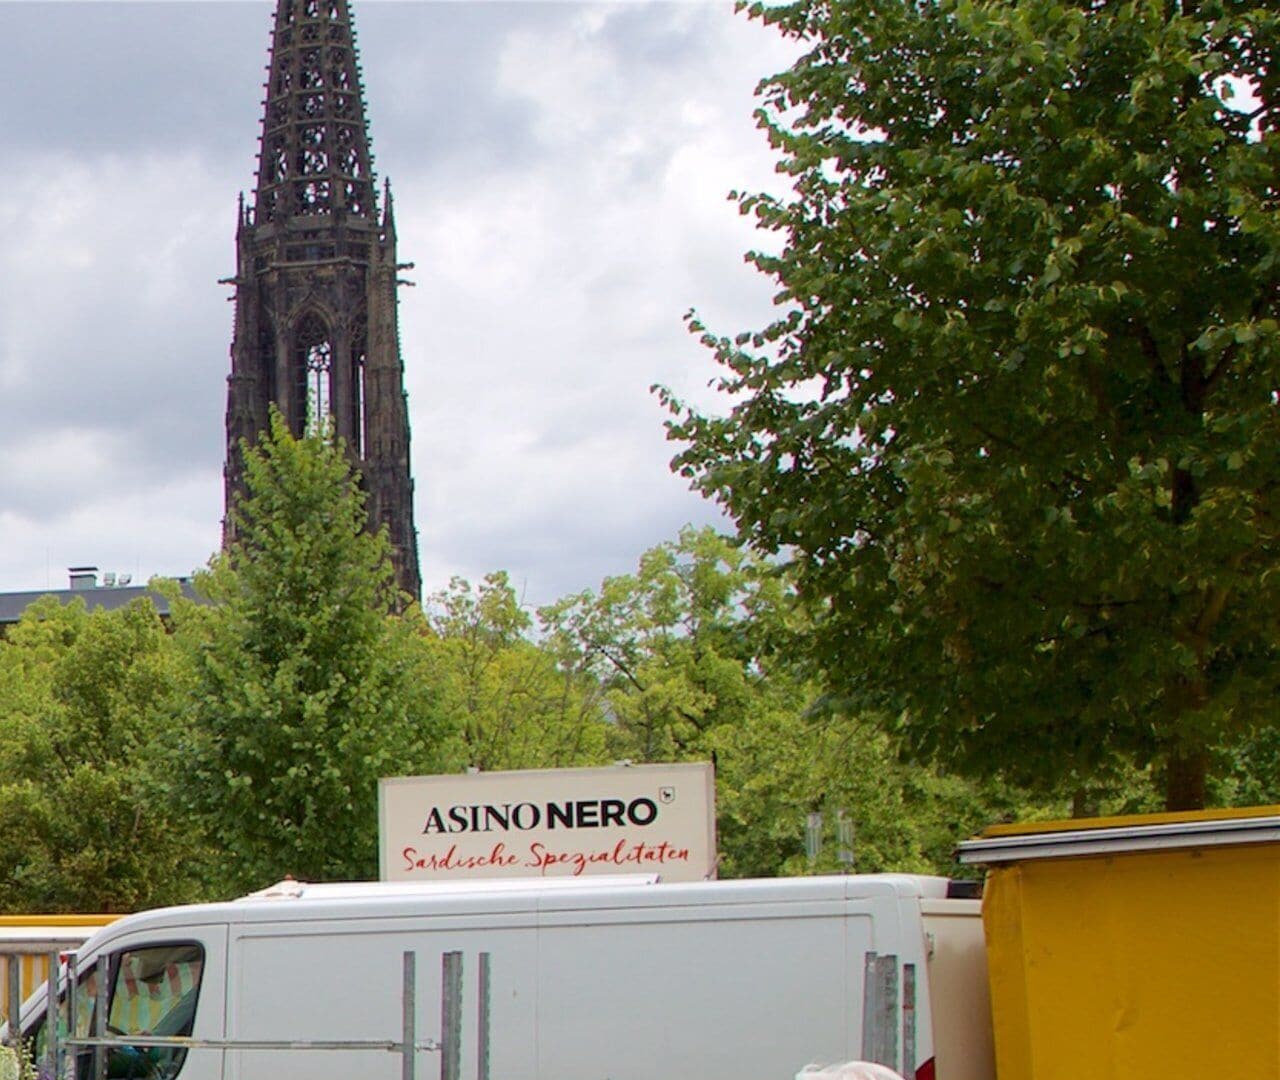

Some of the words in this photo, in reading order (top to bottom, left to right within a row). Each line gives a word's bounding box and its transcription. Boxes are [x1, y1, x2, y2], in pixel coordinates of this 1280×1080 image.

[422, 802, 541, 834] ASINO
[546, 798, 658, 829] NERO
[402, 842, 518, 872] Sardische
[525, 838, 689, 877] Spezialitäten
